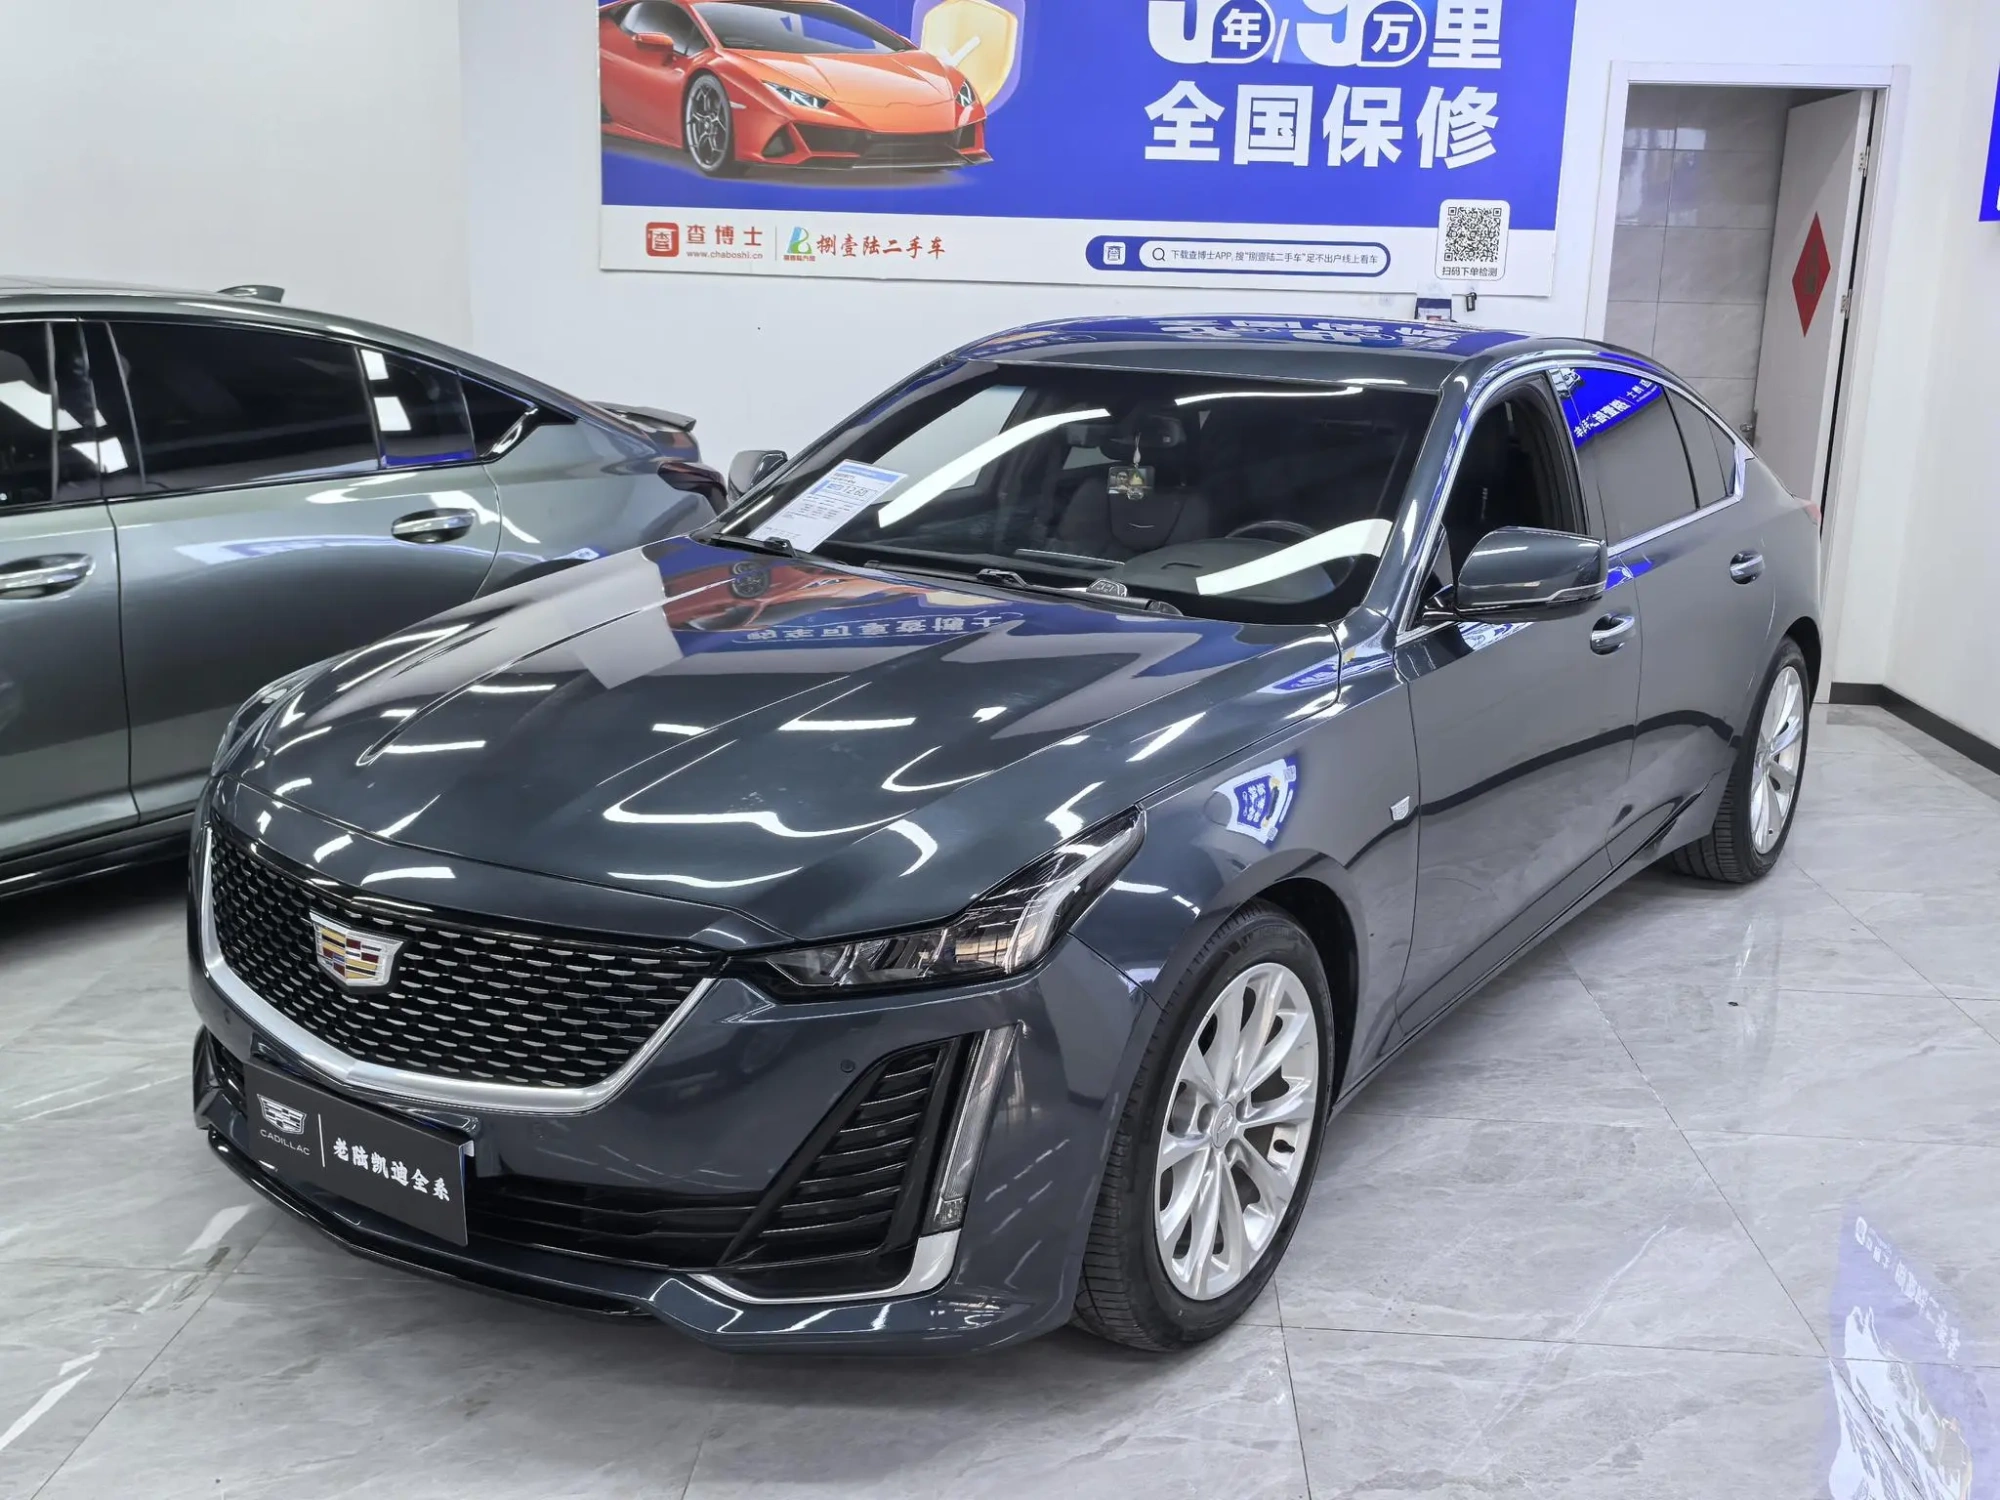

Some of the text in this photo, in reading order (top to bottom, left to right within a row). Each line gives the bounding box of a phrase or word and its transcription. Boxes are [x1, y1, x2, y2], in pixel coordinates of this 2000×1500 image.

[1144, 80, 1500, 169] 全国保修
[686, 224, 763, 246] 查博士
[816, 234, 946, 259] 捌壹陆二手车
[686, 250, 763, 260] www.chaboshi.cn
[1441, 266, 1498, 277] 扫码下单检测
[259, 1129, 310, 1156] CADILLAC
[333, 1137, 450, 1201] 老陆凯迪全系
